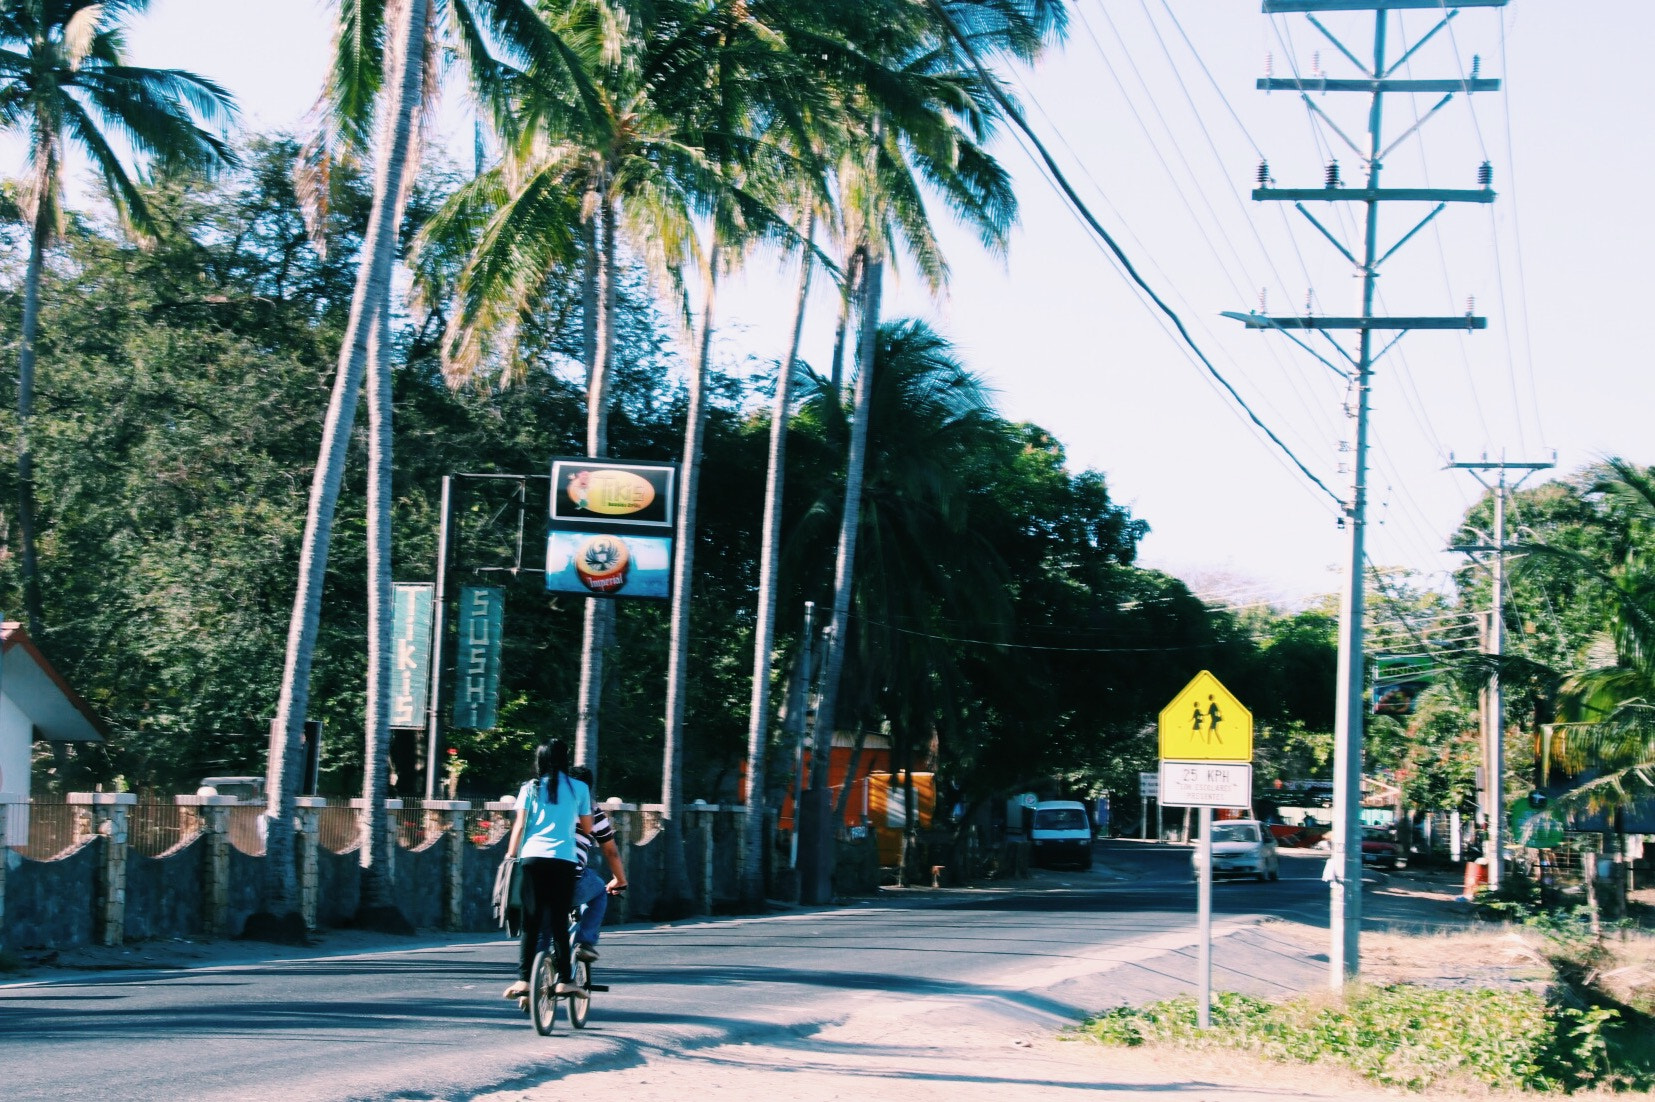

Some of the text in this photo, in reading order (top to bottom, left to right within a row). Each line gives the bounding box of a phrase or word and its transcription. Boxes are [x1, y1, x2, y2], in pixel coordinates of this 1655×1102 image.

[586, 573, 623, 591] Imperial
[1183, 768, 1230, 783] 25 KPH
